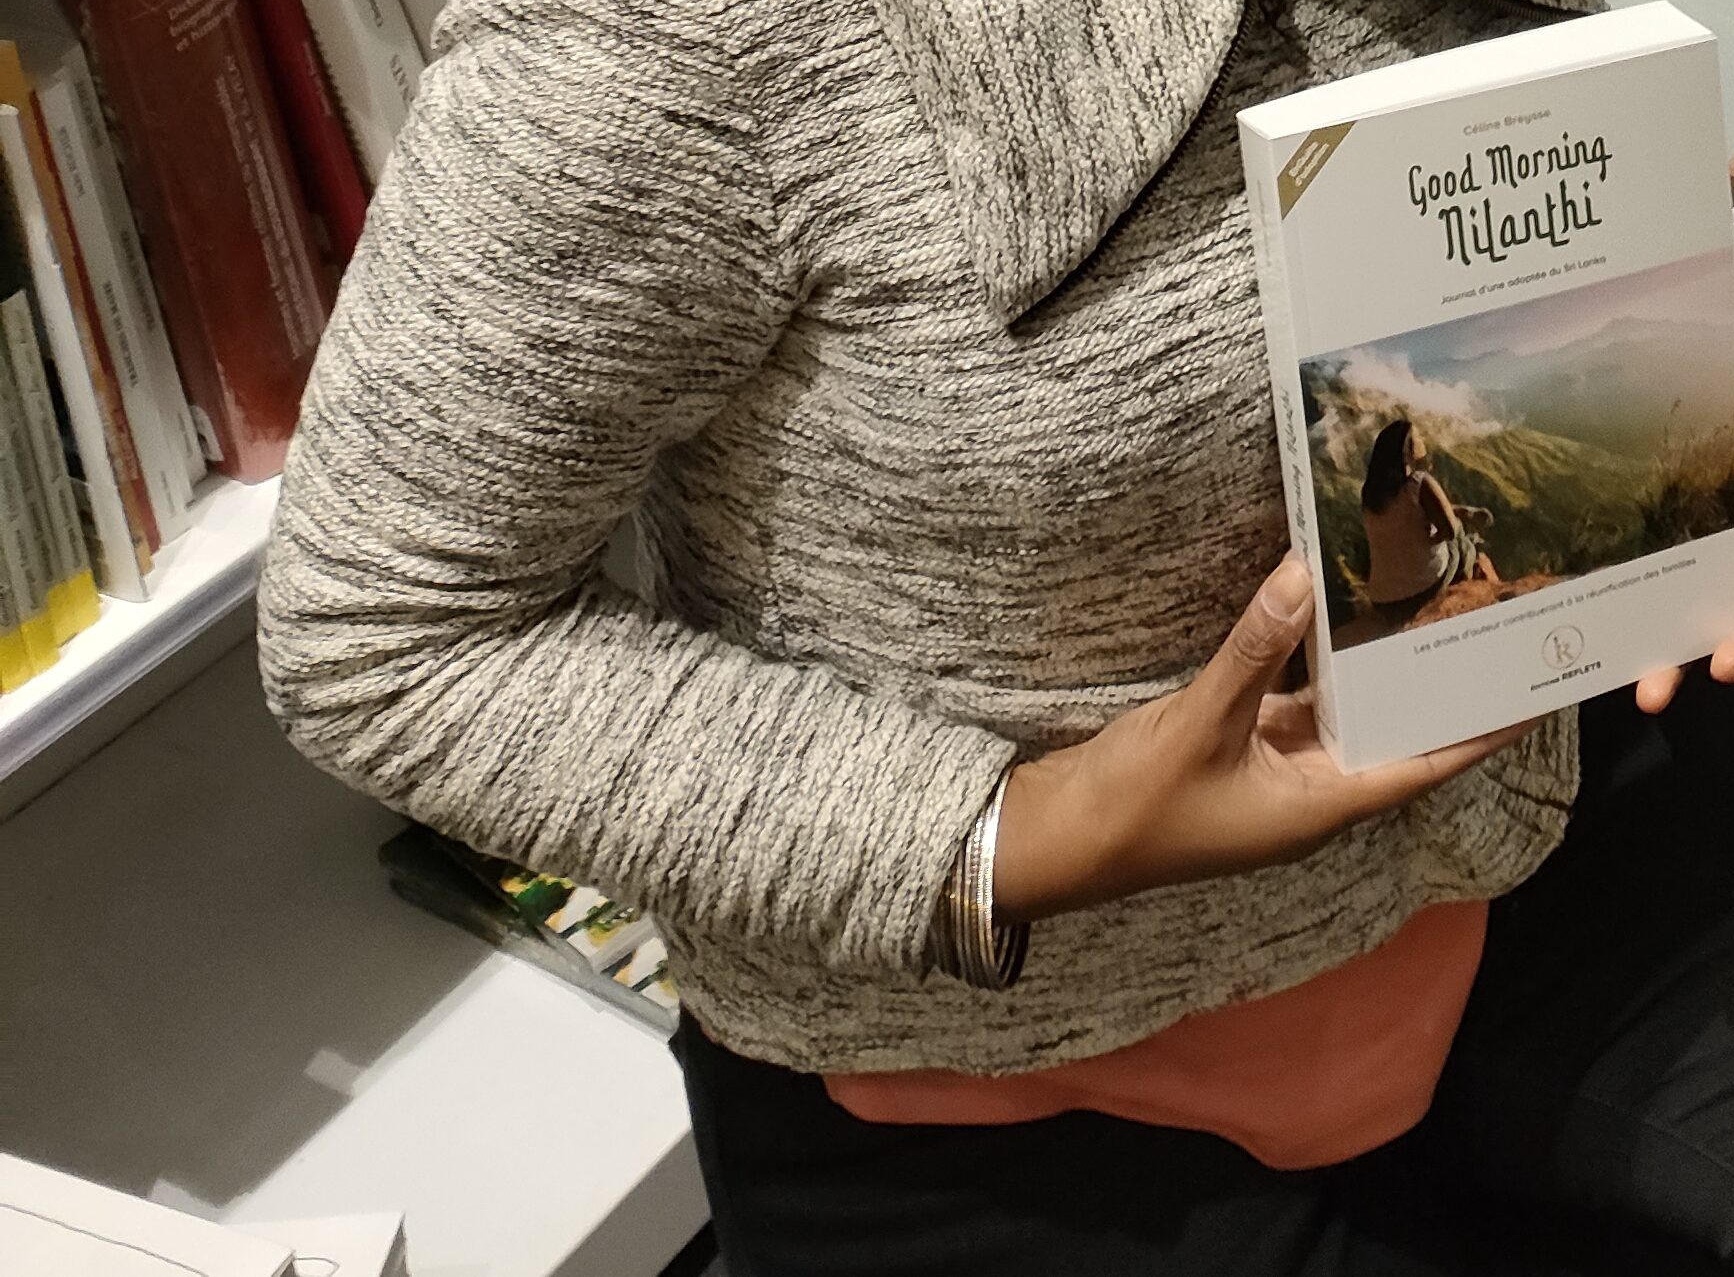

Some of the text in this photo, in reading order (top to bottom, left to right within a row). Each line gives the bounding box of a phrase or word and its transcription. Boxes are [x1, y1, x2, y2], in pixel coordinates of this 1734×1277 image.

[1463, 109, 1552, 136] Céline Breysse
[1408, 131, 1613, 217] Good Morning
[1438, 179, 1603, 266] Nilanthi
[1441, 255, 1606, 305] Journal d'une adoptée du Sri Lanka
[1413, 643, 1431, 655] Les
[1433, 632, 1460, 650] droits
[1461, 622, 1500, 640] d'auteur
[1503, 601, 1565, 627] contribueront
[1643, 569, 1660, 582] des
[1661, 557, 1697, 576] familles
[1561, 660, 1602, 681] REFLETS
